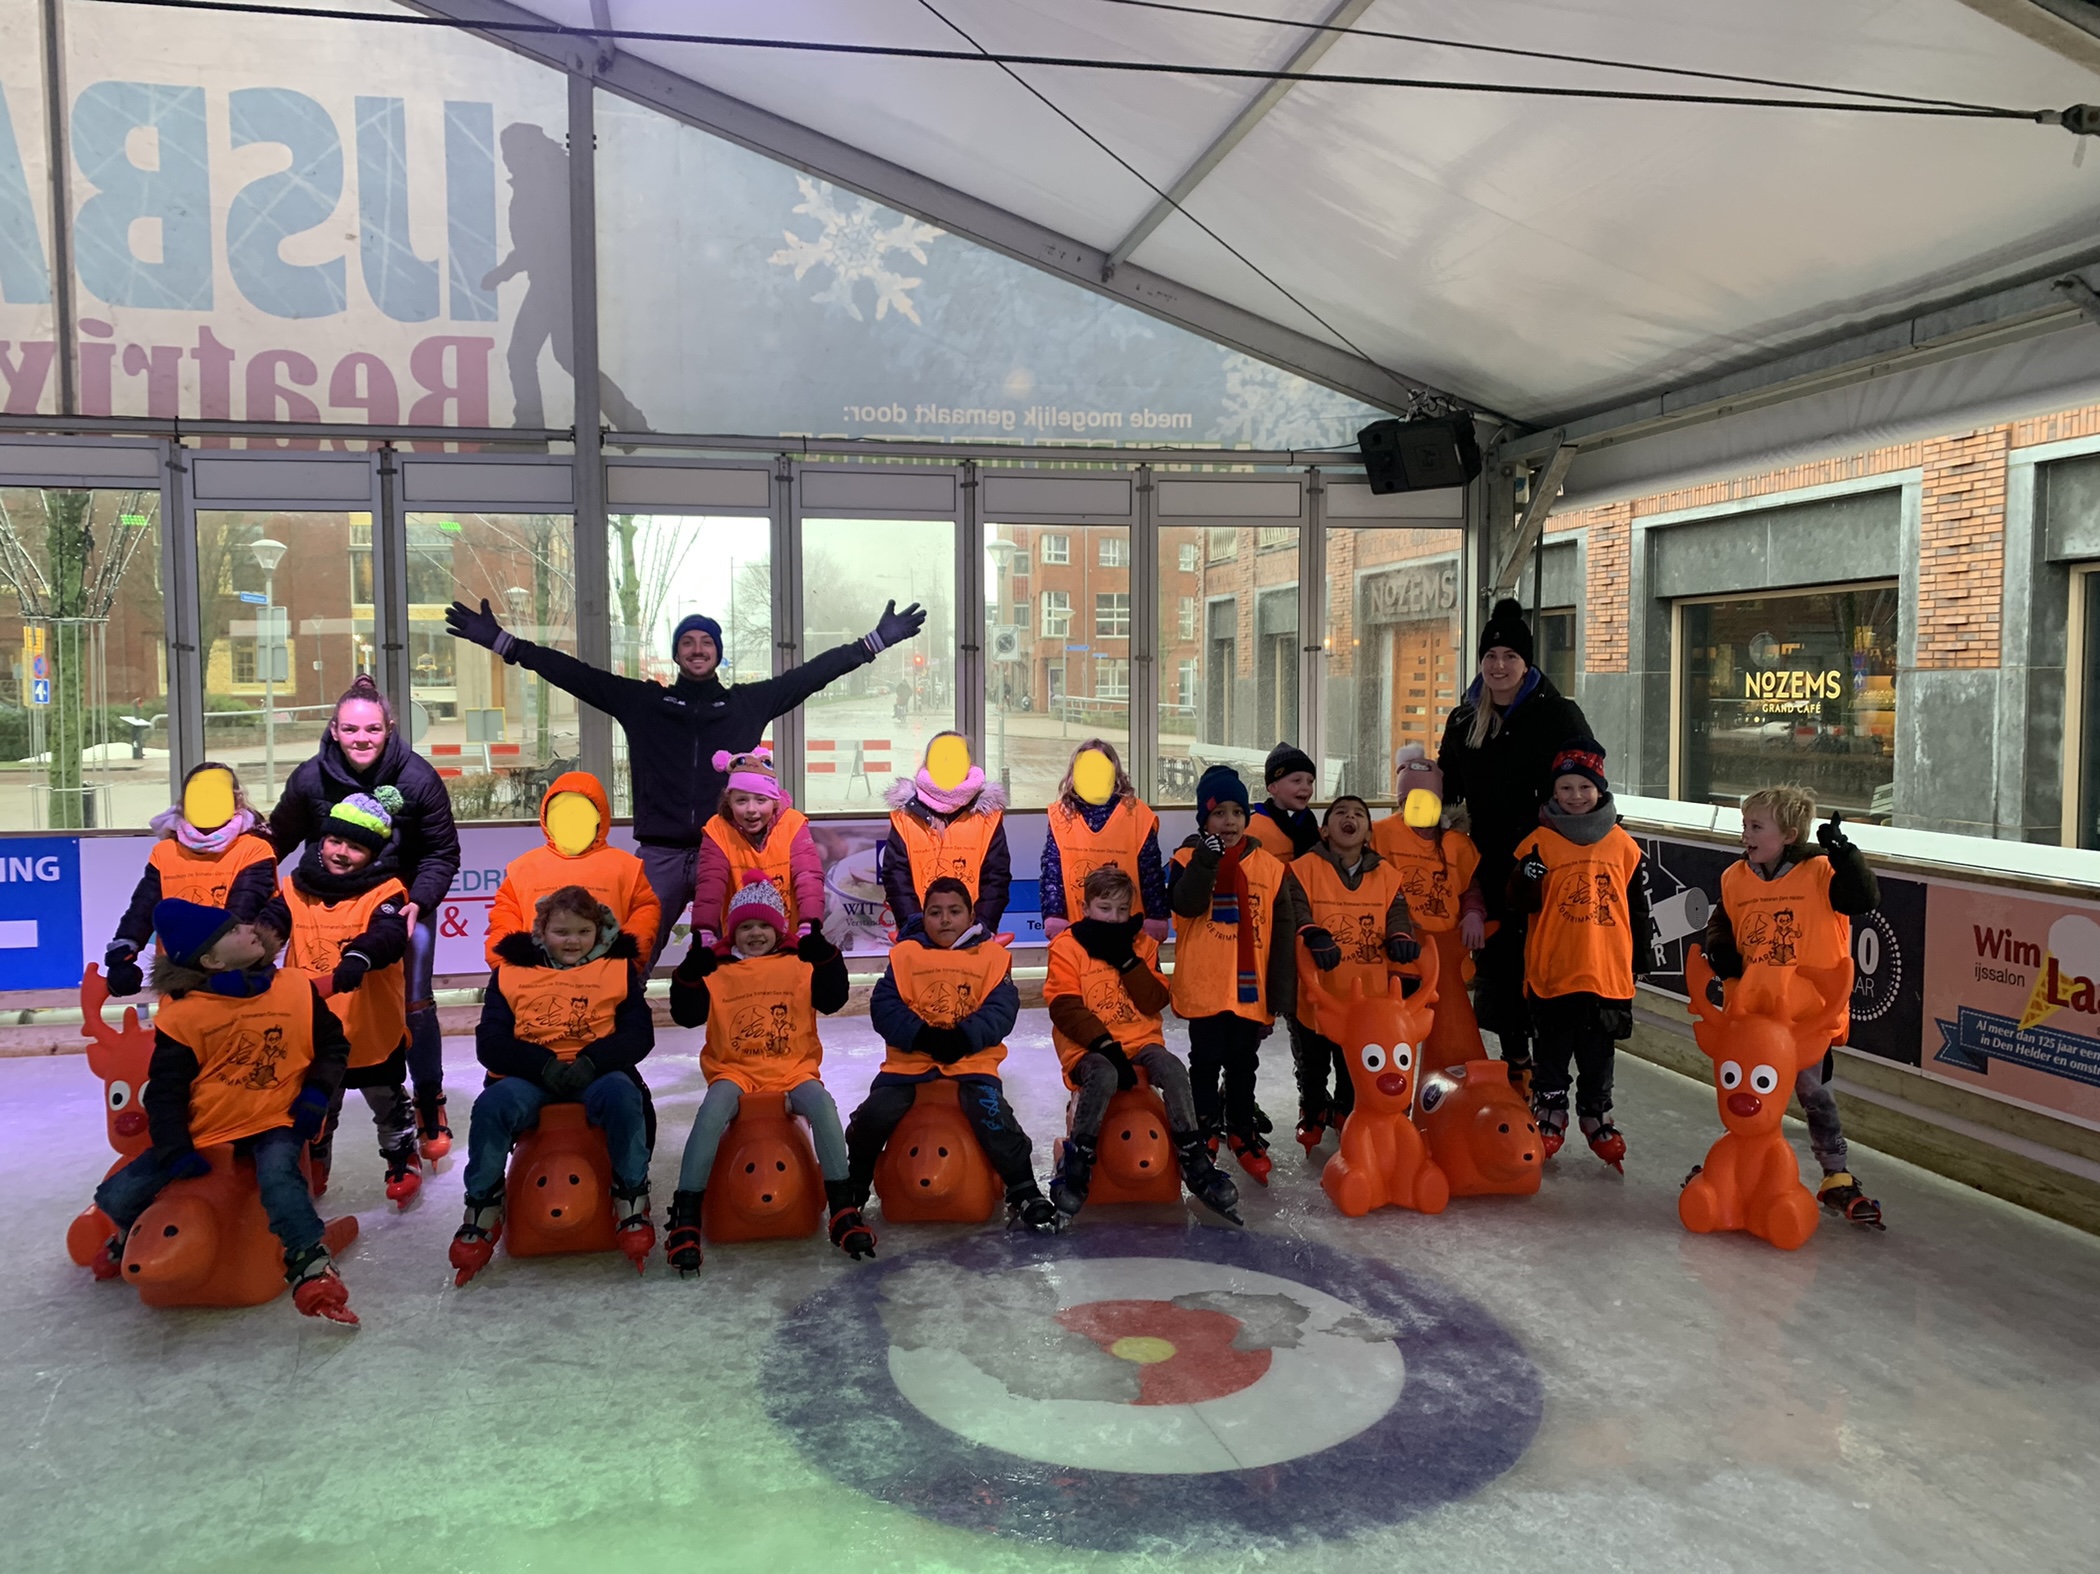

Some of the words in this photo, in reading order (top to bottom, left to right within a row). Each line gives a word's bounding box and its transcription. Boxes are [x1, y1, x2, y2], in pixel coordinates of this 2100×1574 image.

[1370, 570, 1455, 616] NOZEMS
[1745, 670, 1841, 699] NOZEMS
[1762, 703, 1795, 714] GRAND
[1797, 701, 1821, 714] CAFÉ
[439, 905, 469, 938] &
[843, 903, 875, 916] WIT
[1973, 924, 2041, 968] Wim
[1974, 962, 2025, 988] ijssalon
[2047, 956, 2100, 1015] La
[1976, 1019, 1987, 1031] Al
[1988, 1024, 2014, 1039] meer
[2016, 1030, 2036, 1044] dan
[2038, 1036, 2055, 1049] 125
[2056, 1040, 2079, 1055] jaar
[1980, 1034, 1990, 1046] in
[1992, 1036, 2013, 1052] Den
[2015, 1042, 2052, 1062] Helder
[2053, 1055, 2067, 1067] en
